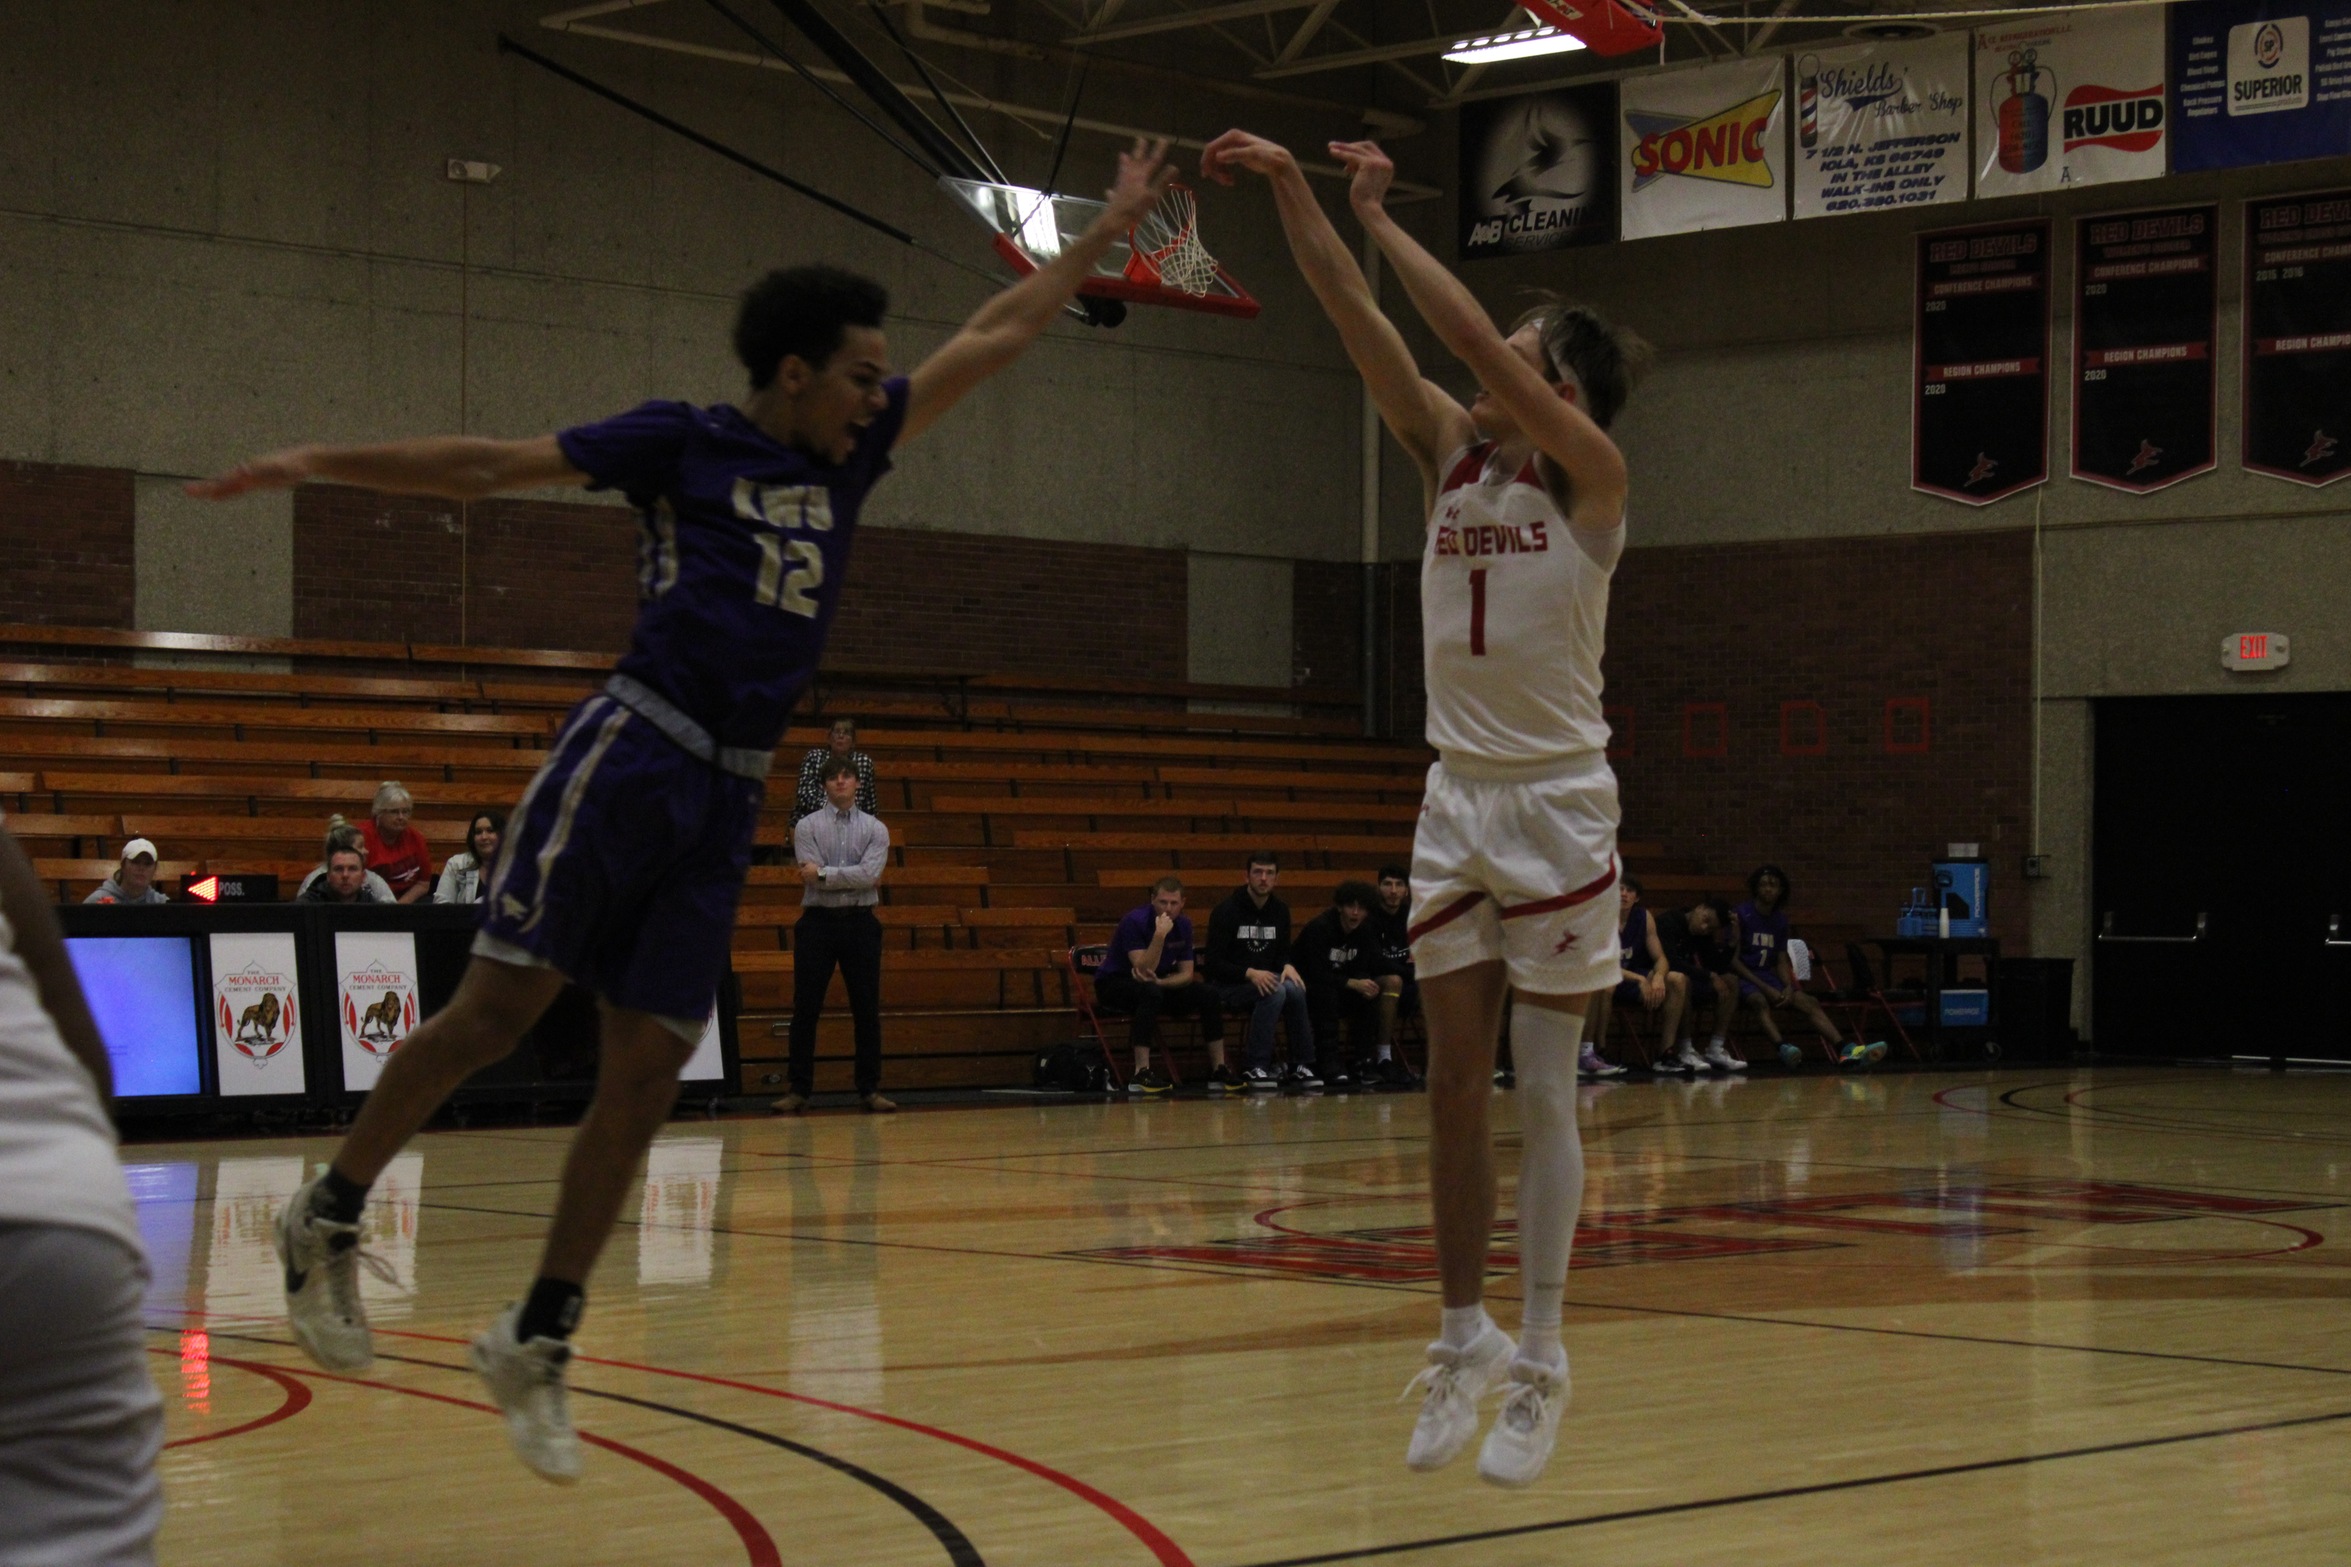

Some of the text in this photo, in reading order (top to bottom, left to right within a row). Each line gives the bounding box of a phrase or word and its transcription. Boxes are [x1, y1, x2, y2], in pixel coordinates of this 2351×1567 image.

[2234, 74, 2303, 101] SUPERIOR
[1875, 91, 1963, 118] Barber Shop
[2064, 98, 2164, 139] RUUD
[1635, 117, 1768, 177] SONIC
[1805, 132, 1961, 160] 7 1/2 N. JEFFERSON
[1820, 148, 1946, 172] IOLA, KS 66749
[1830, 162, 1935, 184] IN THE ALLEY
[1821, 175, 1946, 199] WALK-INS ONLY
[2260, 205, 2301, 230] RED
[2090, 213, 2204, 246] RED DEVILS
[1929, 232, 2038, 263] RED DEVILS
[2264, 248, 2321, 264] CONFERENCE
[2094, 257, 2200, 278] CONFERENCE CHAMPIONS
[1934, 275, 2033, 295] CONFERENCE CHAMPIONS
[2085, 283, 2108, 296] 2020
[1925, 300, 1947, 313] 2020
[2104, 345, 2187, 363] REGION CHAMPIONS
[2275, 338, 2308, 351] REGION
[1943, 361, 2020, 378] REGION CHAMPIONS
[2084, 369, 2107, 382] 2020
[1925, 383, 1947, 396] 2020
[1462, 521, 1549, 556] DEVILS
[752, 531, 825, 619] 12
[1469, 569, 1487, 657] 1
[2240, 635, 2268, 659] EXIT
[218, 881, 245, 897] POSS.
[1758, 948, 1768, 968] 1
[228, 975, 280, 986] MONARCH
[353, 974, 401, 984] MONARCH
